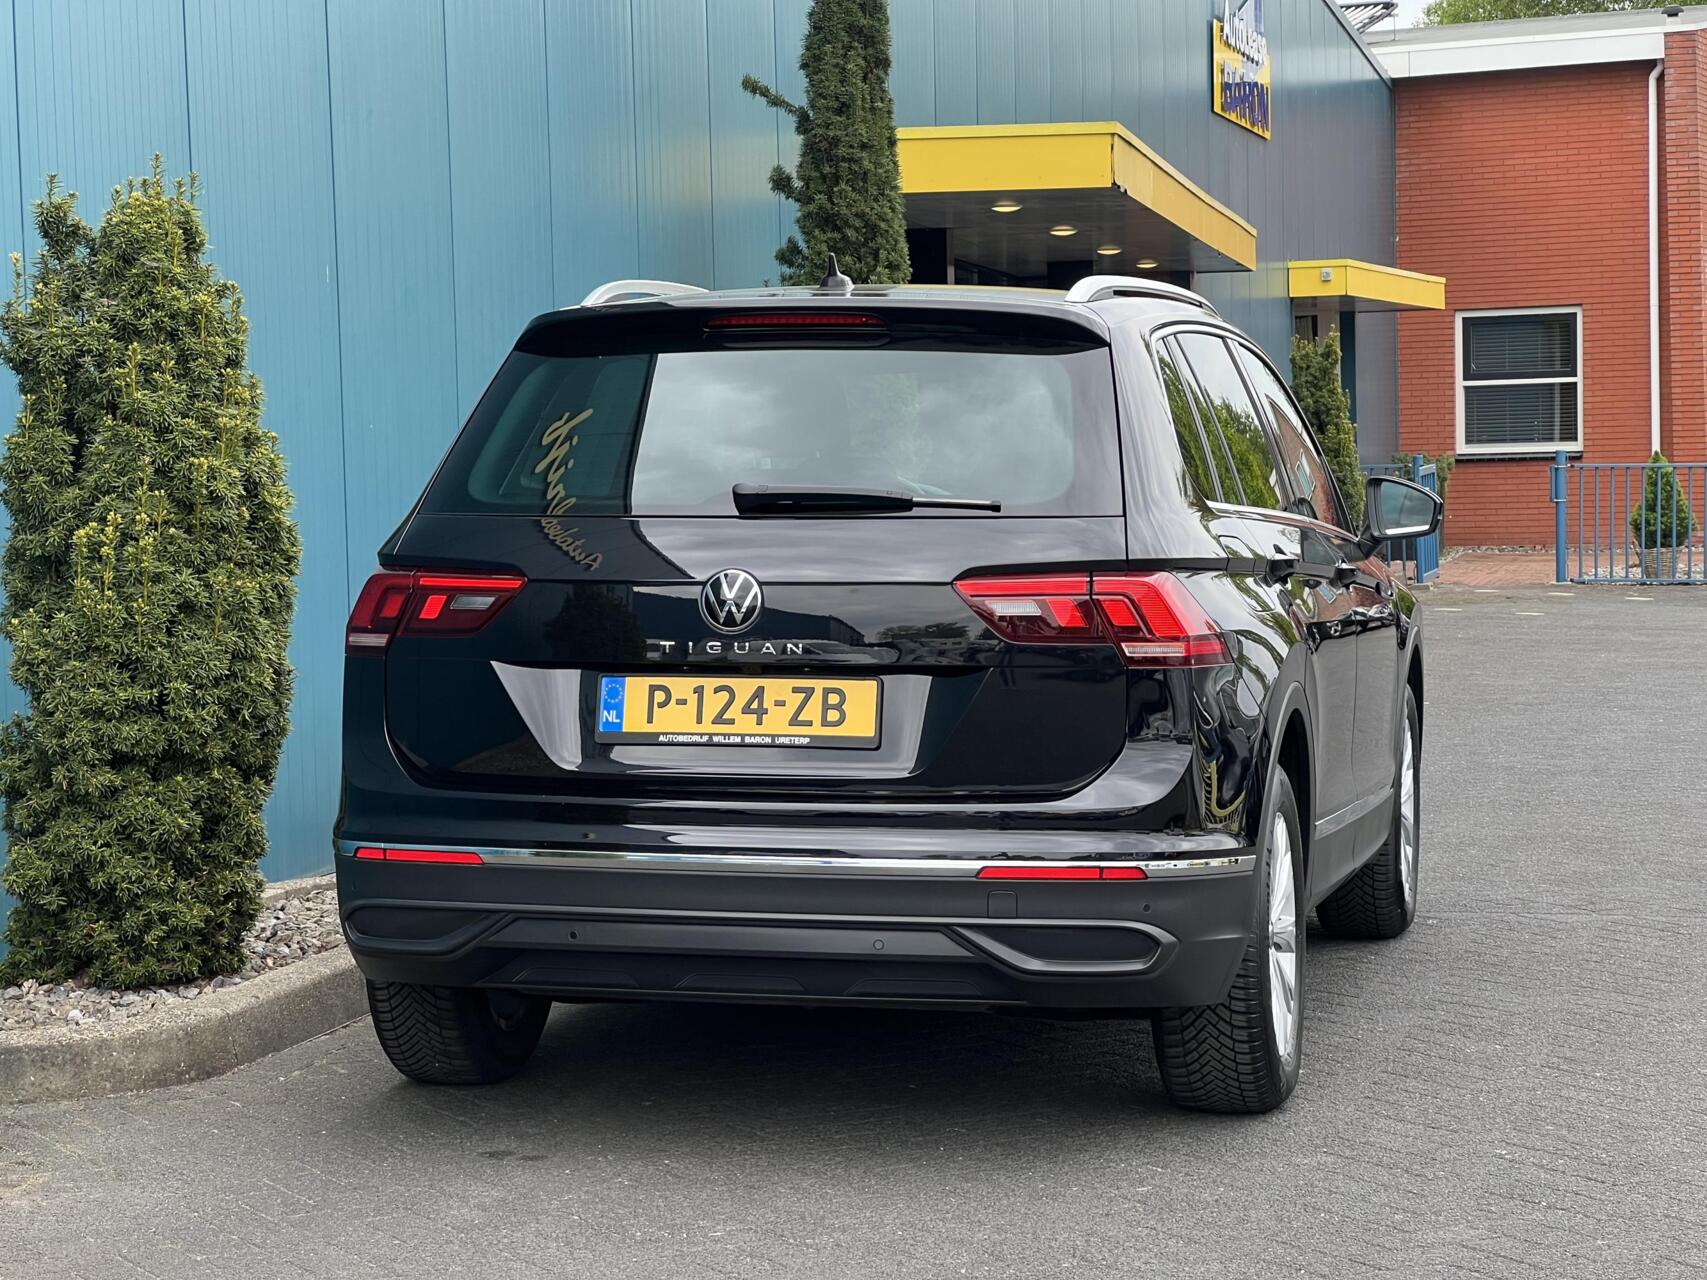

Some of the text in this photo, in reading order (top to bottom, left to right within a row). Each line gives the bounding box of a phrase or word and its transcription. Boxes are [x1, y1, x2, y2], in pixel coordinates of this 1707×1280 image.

[1221, 60, 1270, 132] BARON
[660, 641, 803, 655] TIGUAN
[646, 684, 847, 727] P-124-ZB
[602, 709, 620, 723] NL
[658, 734, 810, 745] AUTOBEDRIJF WILLEM BARON URETERP
